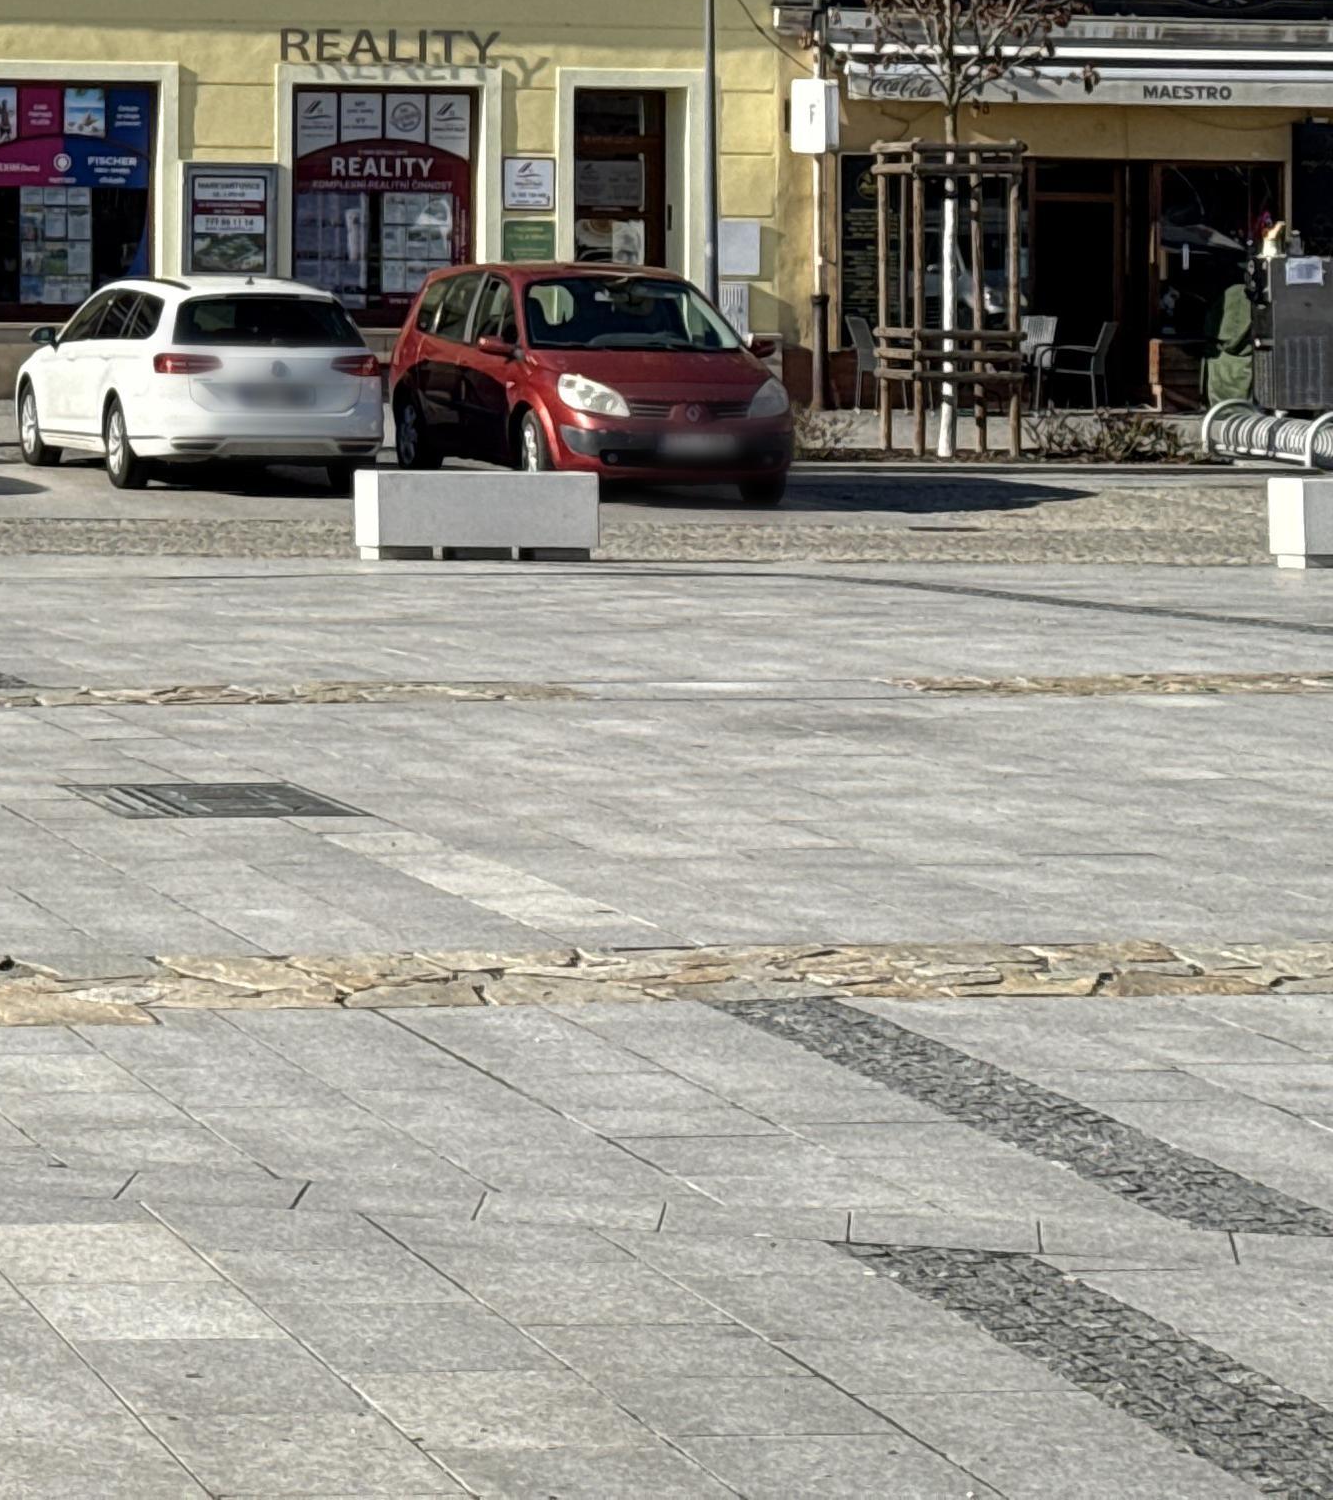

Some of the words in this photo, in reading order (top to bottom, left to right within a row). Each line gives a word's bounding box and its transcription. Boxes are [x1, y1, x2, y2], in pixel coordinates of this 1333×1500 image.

[280, 28, 500, 64] REALITY
[1143, 85, 1232, 100] MAESTRO
[331, 156, 435, 178] REALITY
